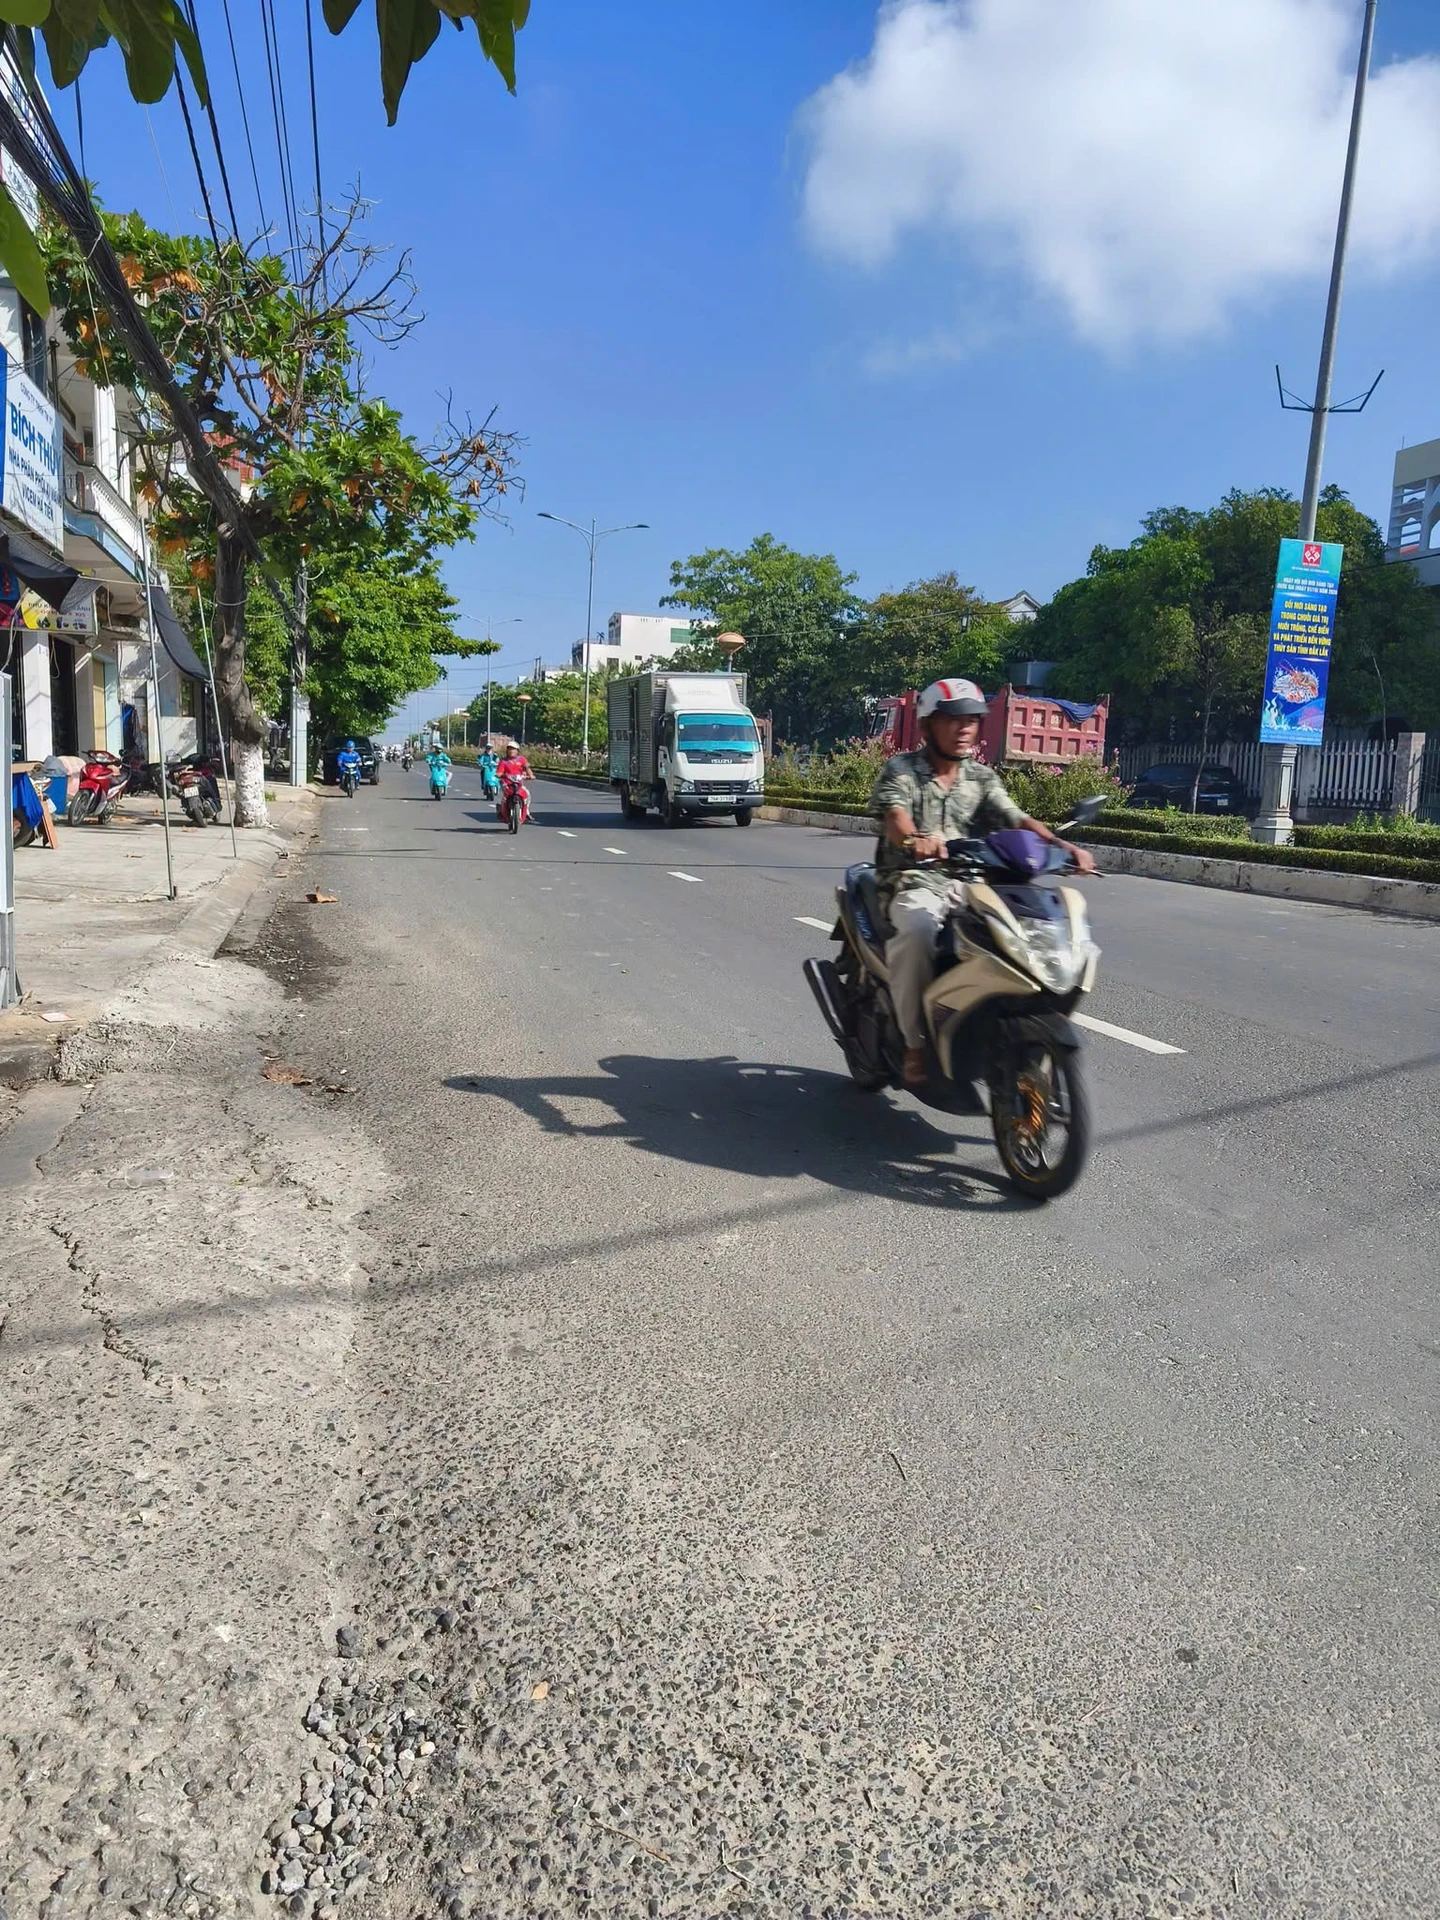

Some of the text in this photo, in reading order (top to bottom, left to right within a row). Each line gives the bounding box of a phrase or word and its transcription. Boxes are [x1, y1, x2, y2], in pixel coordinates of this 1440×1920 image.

[11, 402, 35, 456] BÍCH
[1304, 602, 1317, 612] SÁNG
[1318, 604, 1327, 613] TẠO
[1281, 611, 1296, 620] TRONG
[1312, 613, 1320, 623] GIÁ
[1321, 615, 1329, 625] TRỊ
[1308, 624, 1317, 633] CHẾ
[1273, 632, 1280, 640] VÀ
[1281, 633, 1293, 642] PHÁT
[1286, 643, 1297, 653] SẢN
